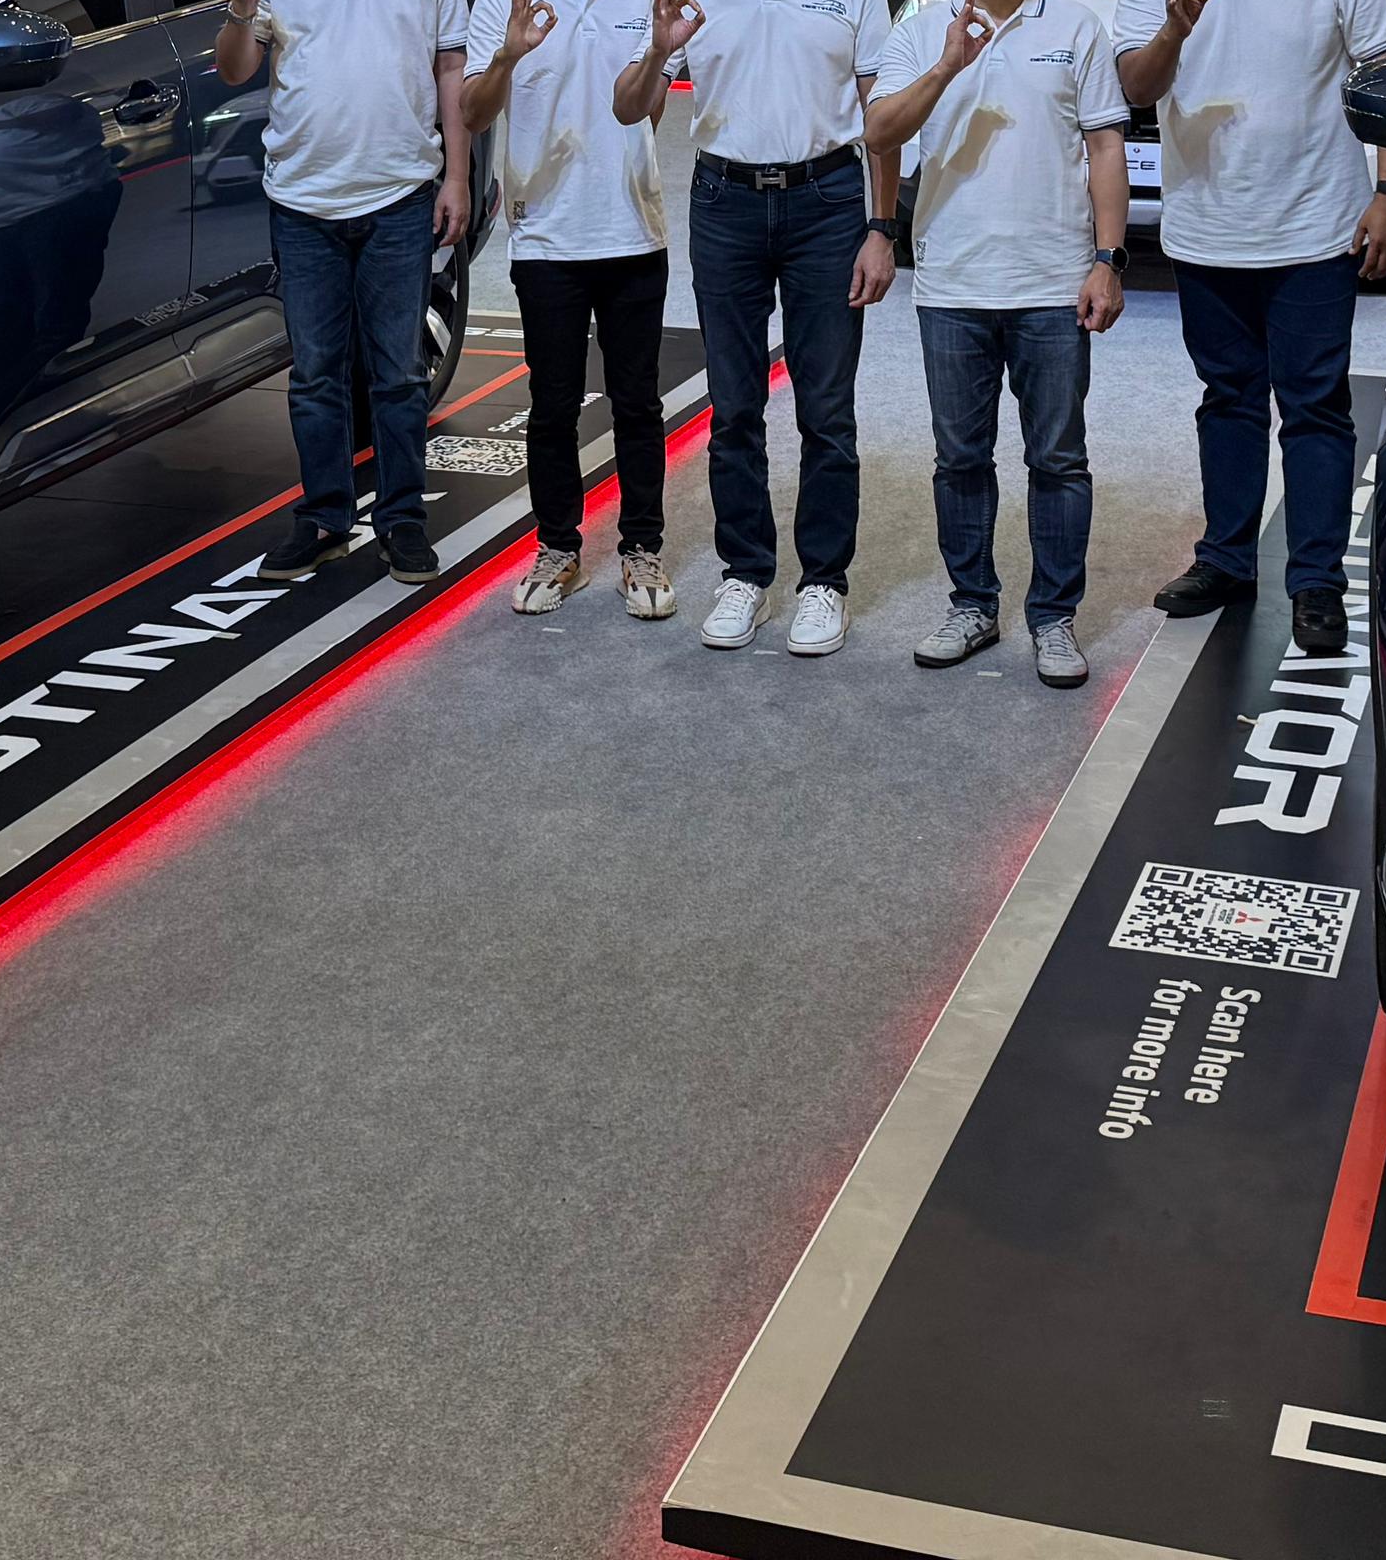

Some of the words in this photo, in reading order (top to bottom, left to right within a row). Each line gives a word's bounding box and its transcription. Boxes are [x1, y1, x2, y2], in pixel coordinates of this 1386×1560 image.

[1150, 979, 1203, 1016] for
[1205, 986, 1262, 1043] Scan
[1121, 1016, 1176, 1081] more
[1184, 1046, 1245, 1104] here
[1098, 1084, 1161, 1140] info
